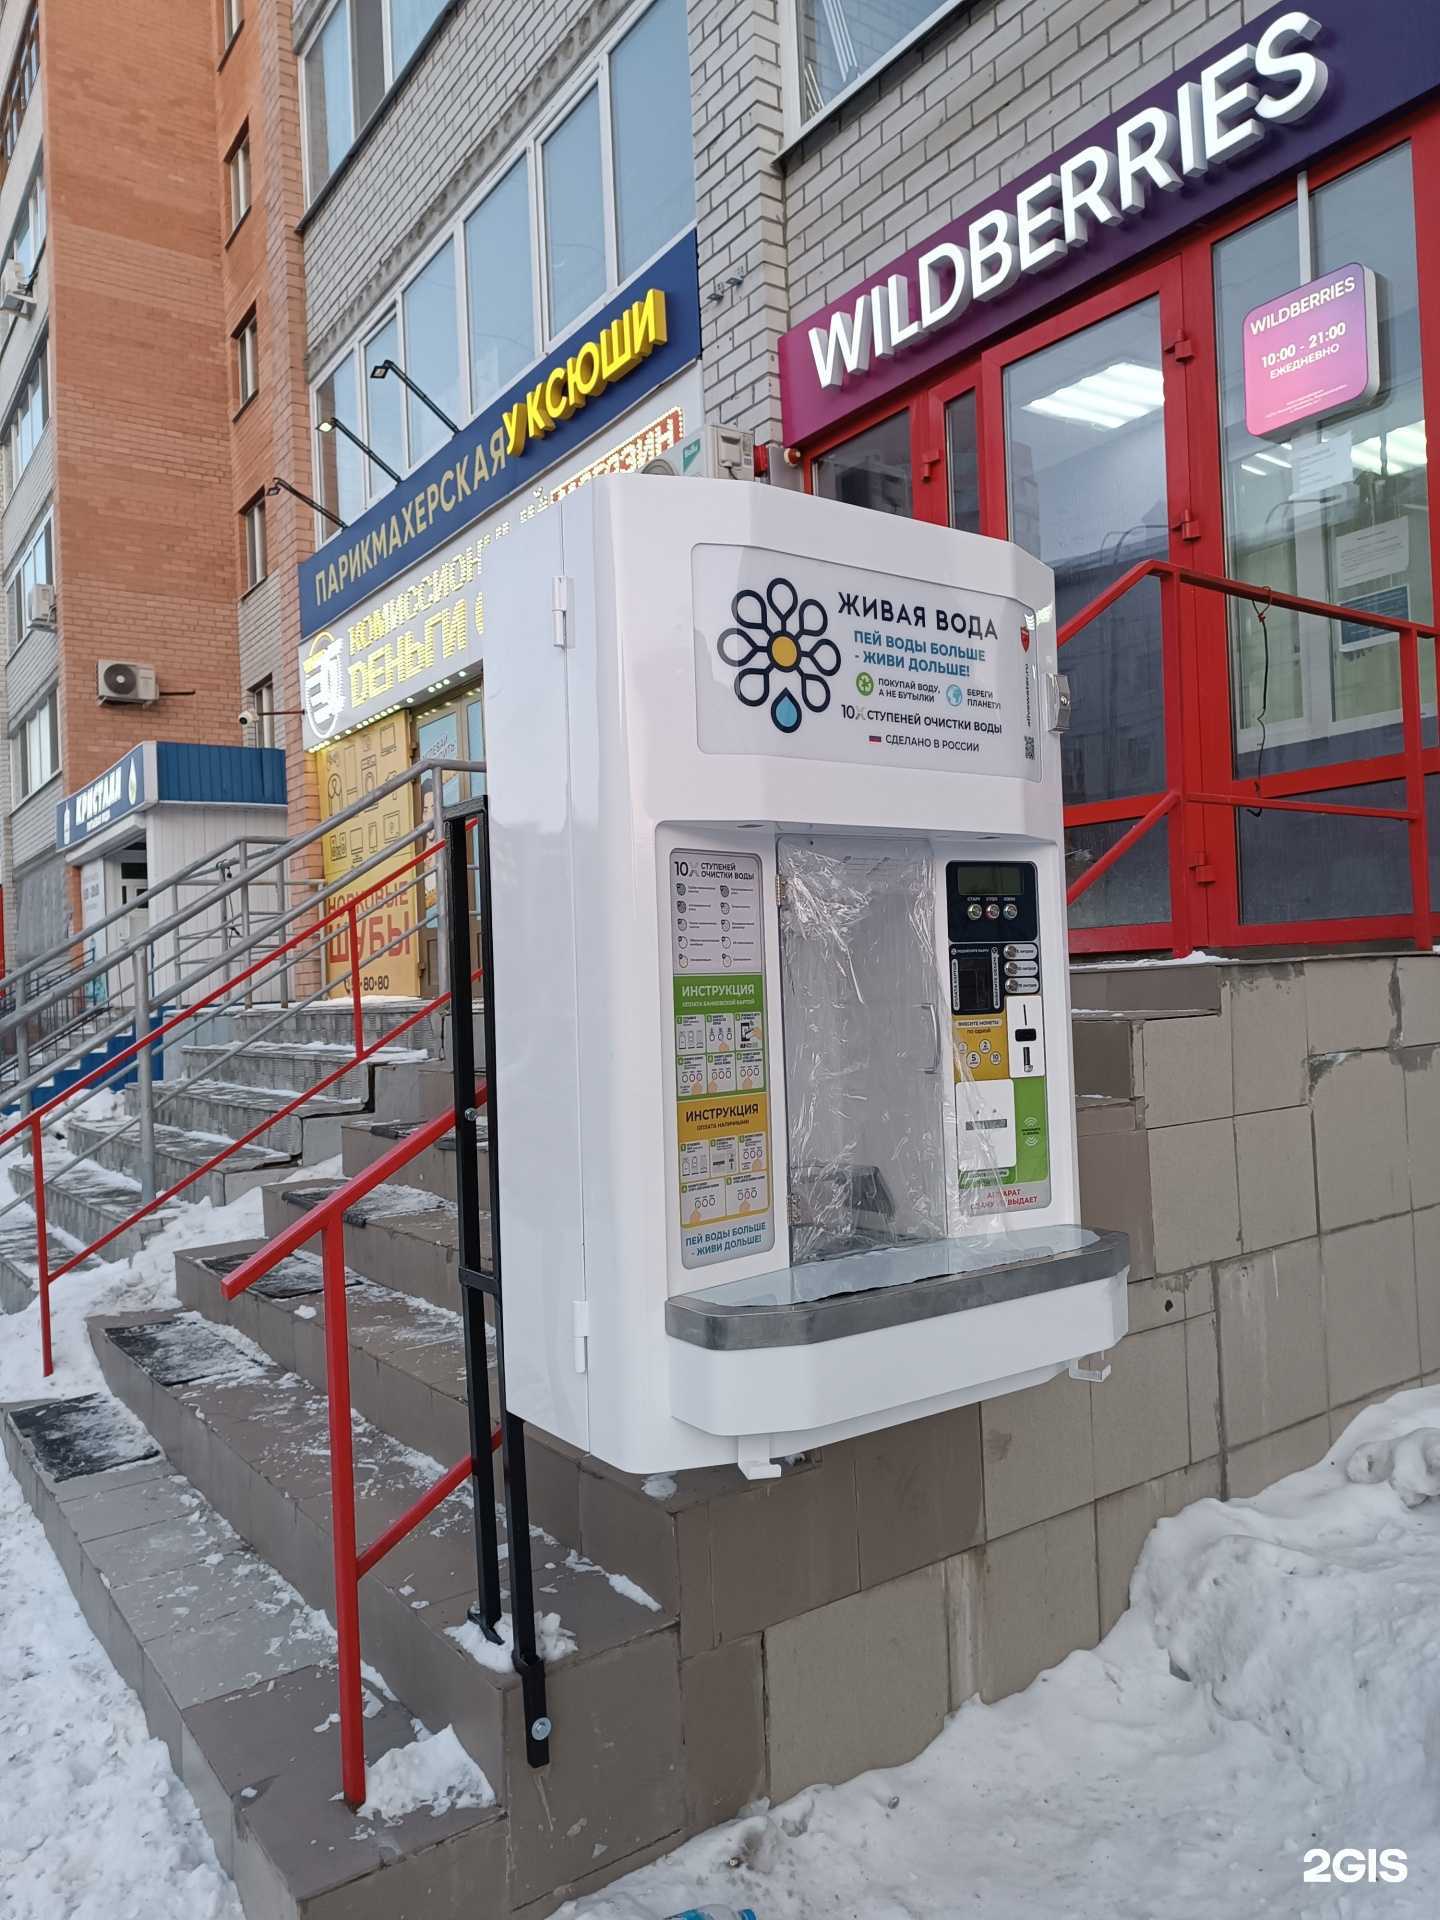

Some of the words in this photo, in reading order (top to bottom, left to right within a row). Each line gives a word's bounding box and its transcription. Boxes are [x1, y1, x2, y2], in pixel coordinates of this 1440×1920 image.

[808, 11, 1328, 391] WILDBERRIES
[1250, 277, 1356, 335] WILDBERRIES
[1261, 344, 1296, 368] 10:00
[1308, 322, 1346, 349] 21:00
[1270, 343, 1340, 380] ЕЖЕДНЕВНО
[315, 427, 506, 606] ПАРИКМАХЕРСКАЯ
[838, 591, 926, 628] ЖИВАЯ
[935, 609, 998, 640] ВОДА
[854, 630, 882, 646] ПЕЙ
[885, 635, 927, 653] ВОДЫ
[930, 642, 986, 661] БОЛЬШЕ
[863, 651, 905, 669] ЖИВИ
[908, 657, 970, 677] ДОЛЬШЕ!
[878, 677, 916, 690] ПОКУПАЙ
[867, 709, 921, 725] СТУПЕНЕЙ
[924, 716, 971, 731] ОЧИСТКИ
[974, 722, 1003, 734] ВОДЫ
[885, 734, 931, 748] СДЕЛАНО
[933, 739, 940, 748] В
[942, 741, 980, 752] РОССИИ
[701, 862, 736, 871] СТУПЕНЕЙ
[701, 871, 733, 879] ОЧИСТКИ
[682, 984, 755, 997] ИНСТРУКЦИЯ
[686, 1103, 759, 1122] ИНСТРУКЦИЯ
[686, 1233, 703, 1246] ПЕЙ
[705, 1229, 731, 1242] ВОДЫ
[732, 1222, 767, 1236] БОЛЬШЕ
[696, 1243, 723, 1256] ЖИВИ
